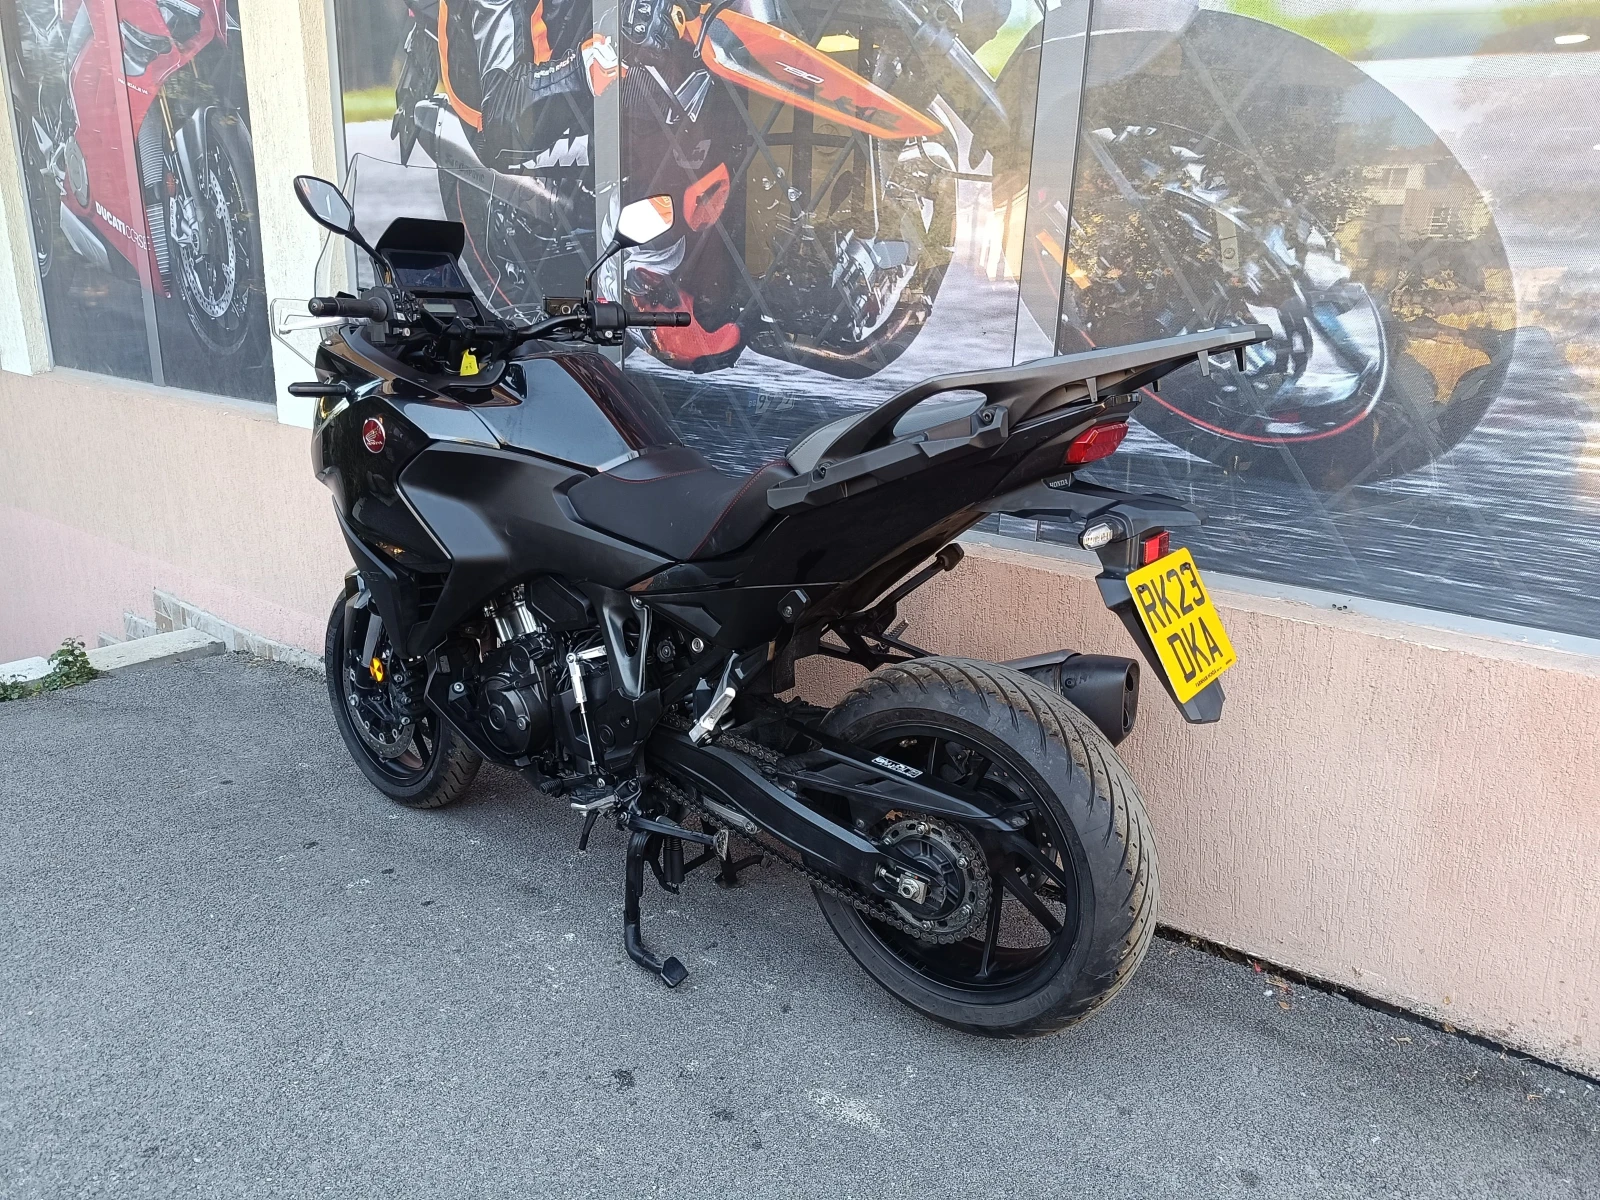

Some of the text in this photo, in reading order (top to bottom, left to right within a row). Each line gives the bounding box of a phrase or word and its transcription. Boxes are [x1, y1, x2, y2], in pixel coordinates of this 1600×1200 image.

[1049, 478, 1069, 488] HONDA
[1135, 561, 1206, 634] RK23
[1166, 616, 1224, 684] DKA
